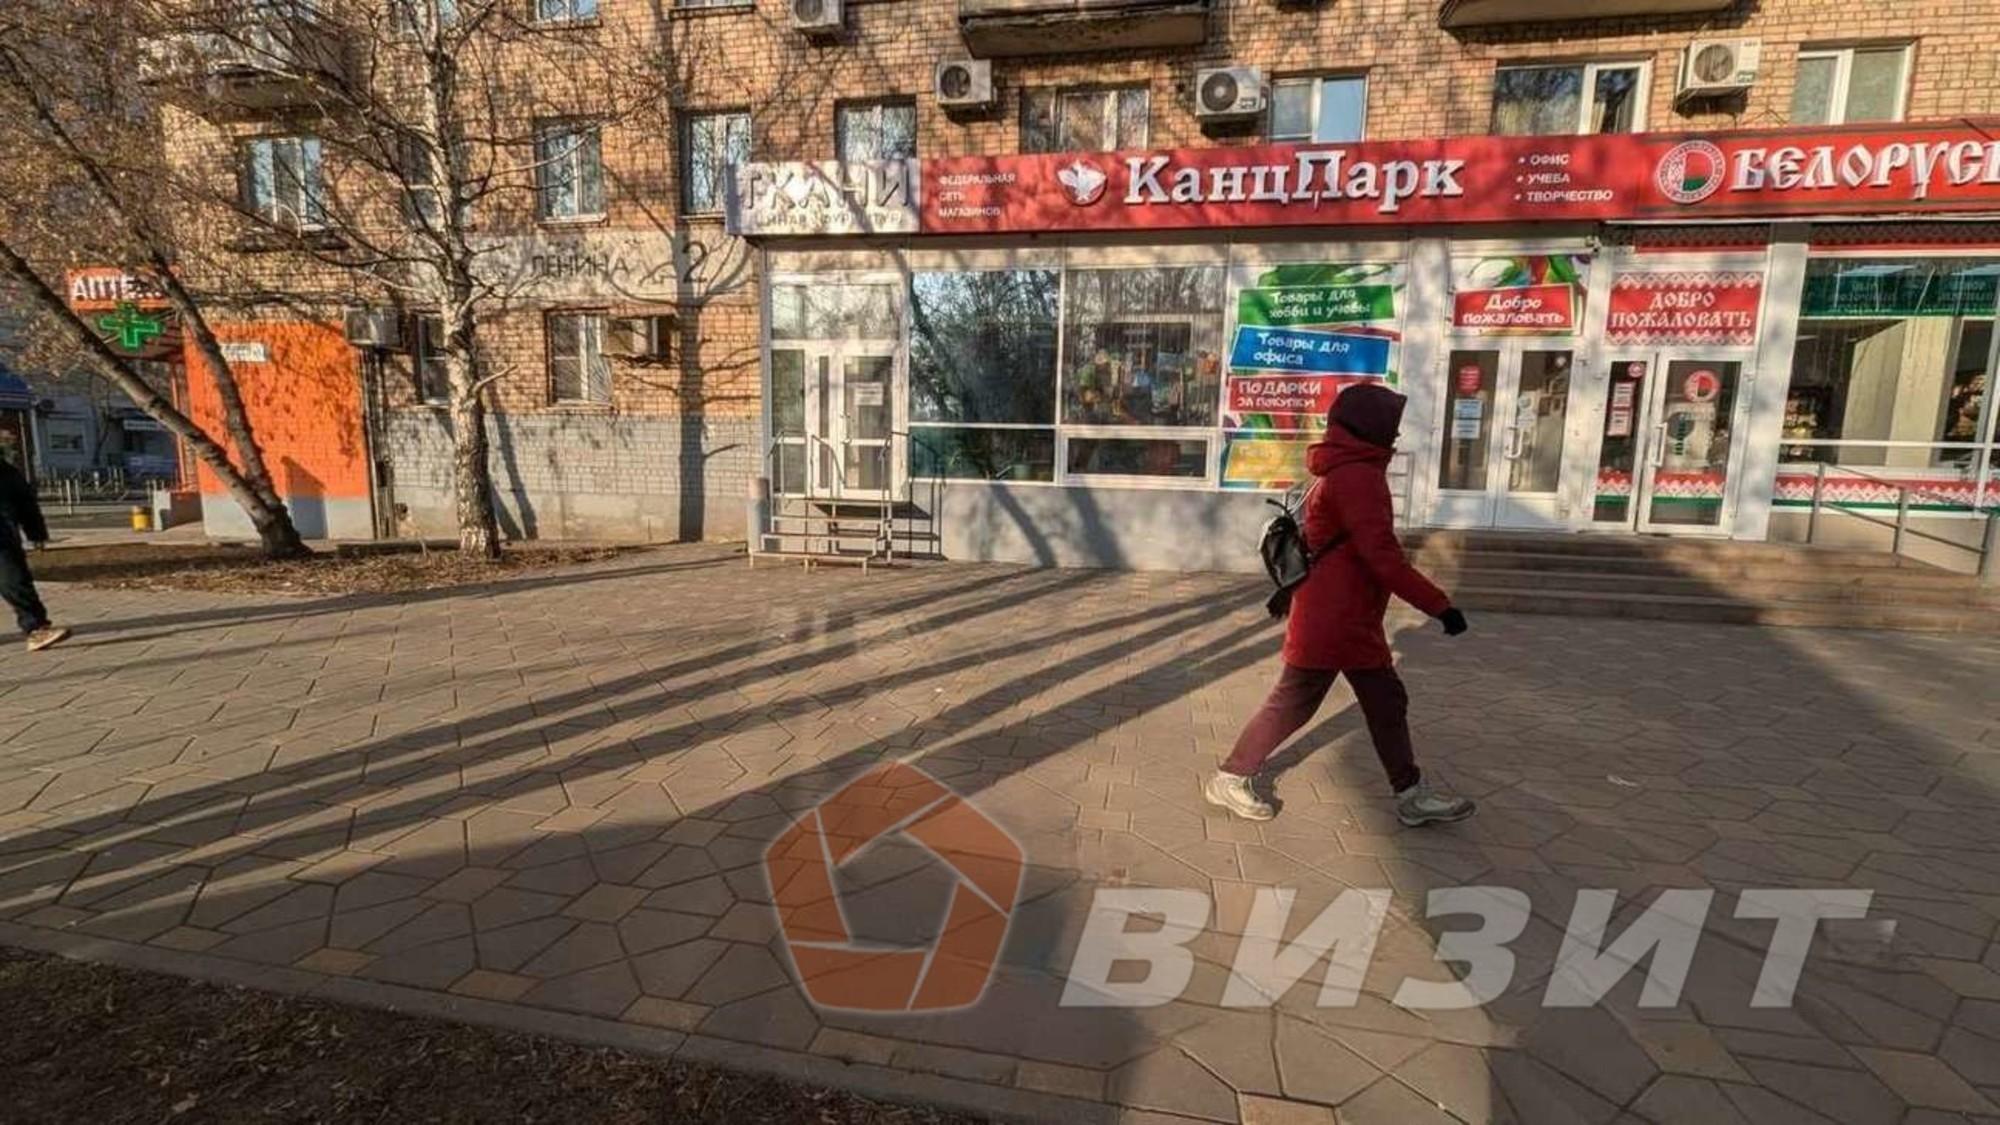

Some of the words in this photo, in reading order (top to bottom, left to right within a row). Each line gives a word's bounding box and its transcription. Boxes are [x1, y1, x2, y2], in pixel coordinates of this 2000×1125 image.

[1529, 153, 1570, 166] ОФИС
[1123, 149, 1466, 214] КанцПарк
[1527, 172, 1571, 185] УЧЕБА
[1526, 189, 1614, 203] ТВОРЧЕСТВО
[532, 254, 630, 278] ЛЕНИНА
[682, 241, 707, 284] 2
[71, 275, 164, 301] АПТЕ
[1272, 291, 1324, 305] Товары
[1329, 289, 1357, 302] для
[1484, 293, 1542, 311] Добро
[1649, 291, 1716, 310] ДОБРО
[1269, 305, 1310, 319] хобби
[1313, 306, 1323, 317] и
[1462, 311, 1565, 326] пожаловать
[1611, 310, 1751, 329] ПОЖАЛОВАТЬ
[1256, 332, 1315, 351] Товары
[1319, 341, 1351, 353] для
[1253, 350, 1304, 366] офиса
[1239, 380, 1322, 396] ПОДАРКИ
[1236, 397, 1254, 408] ЗА
[1255, 396, 1316, 409] ПОКУПКИ
